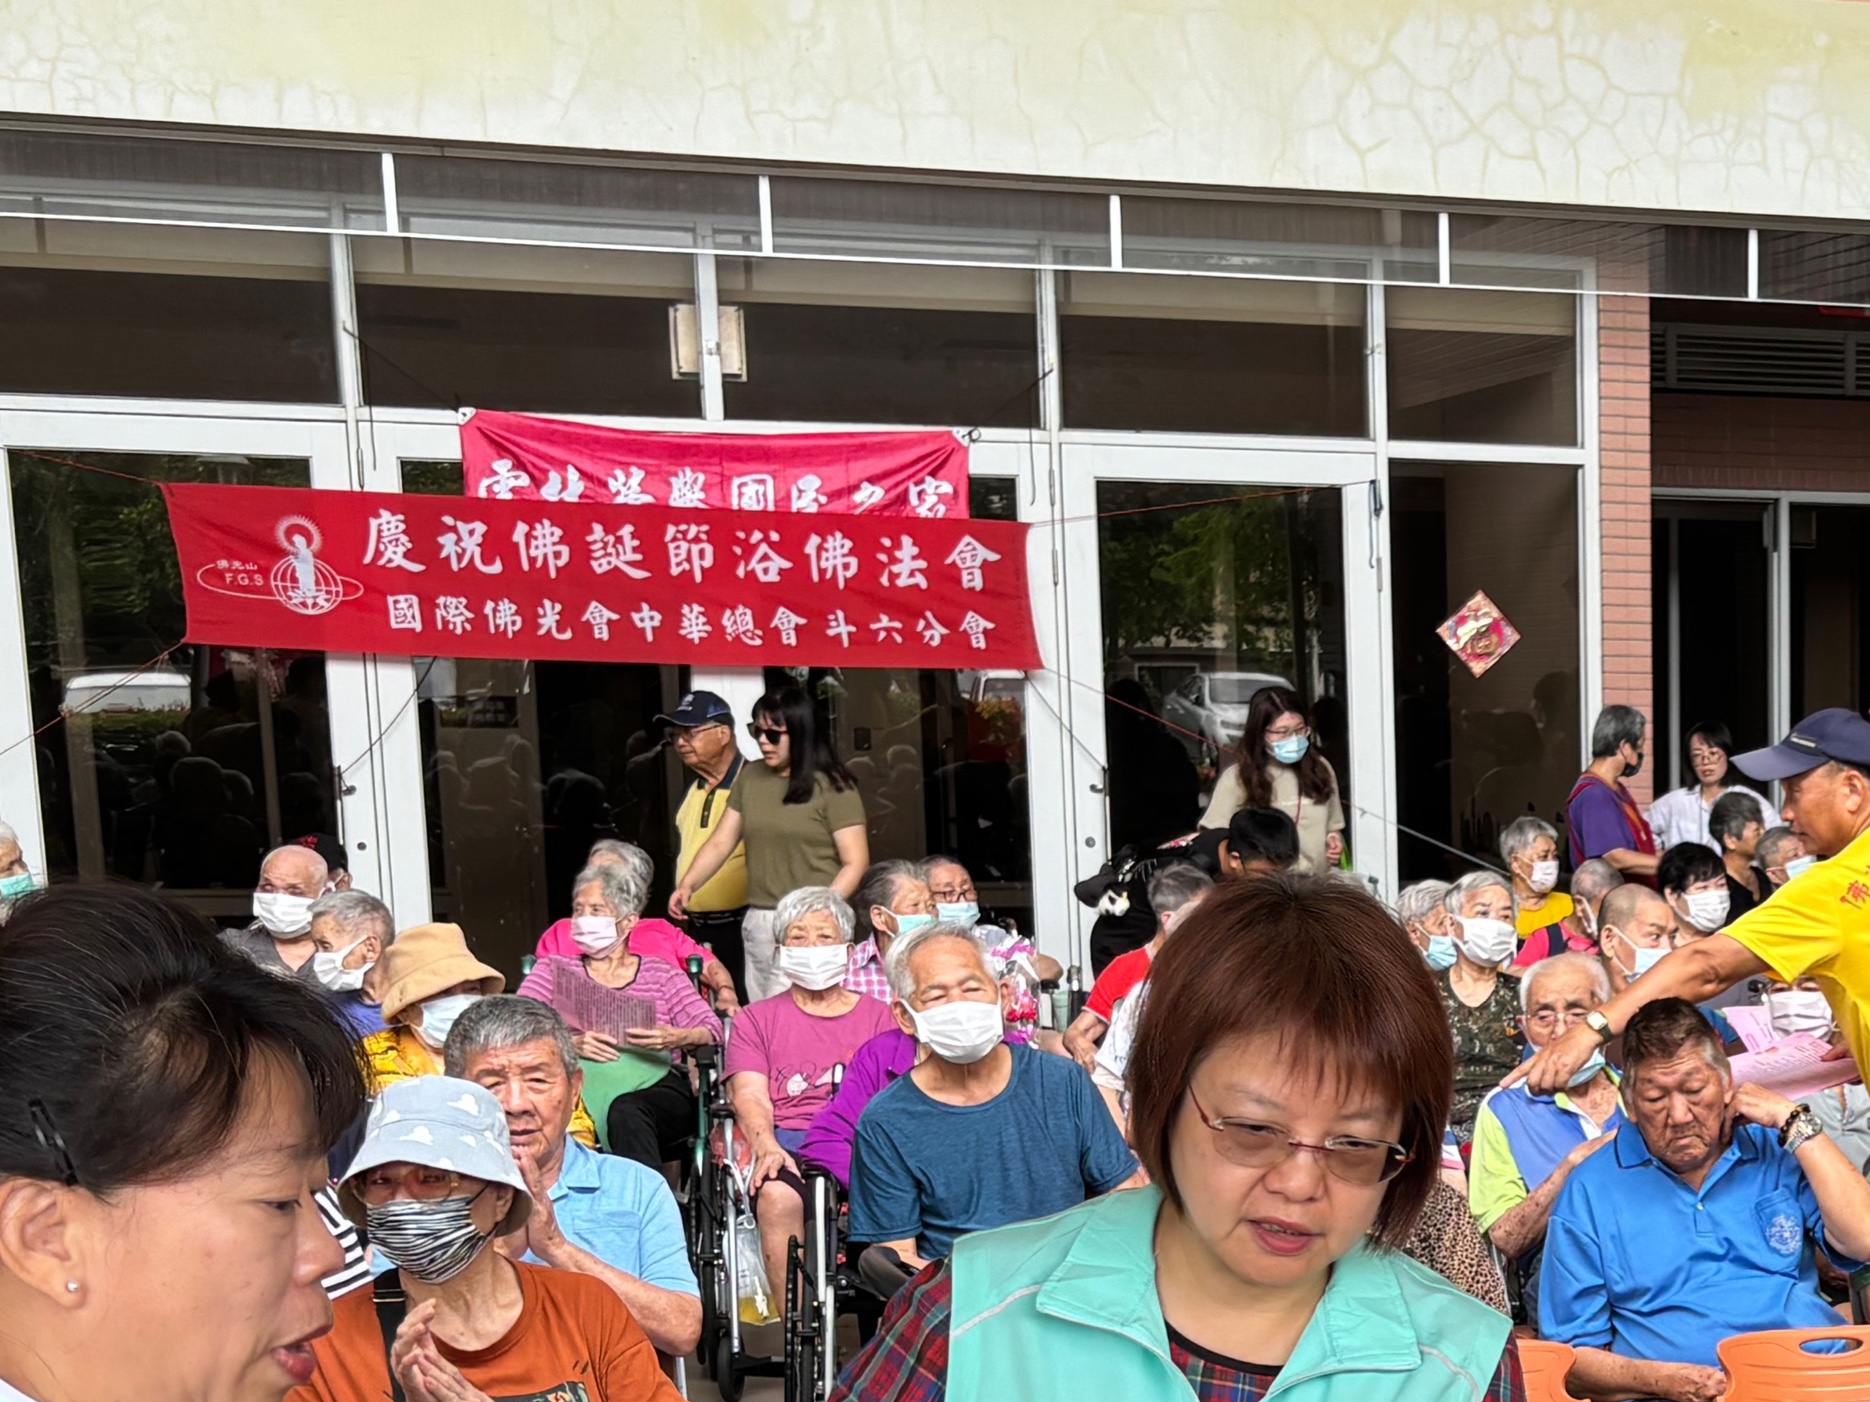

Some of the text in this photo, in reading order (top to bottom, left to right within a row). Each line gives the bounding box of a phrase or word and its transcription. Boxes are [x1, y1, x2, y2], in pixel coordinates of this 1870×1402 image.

[363, 508, 1001, 591] 慶祝佛誕節浴佛法會
